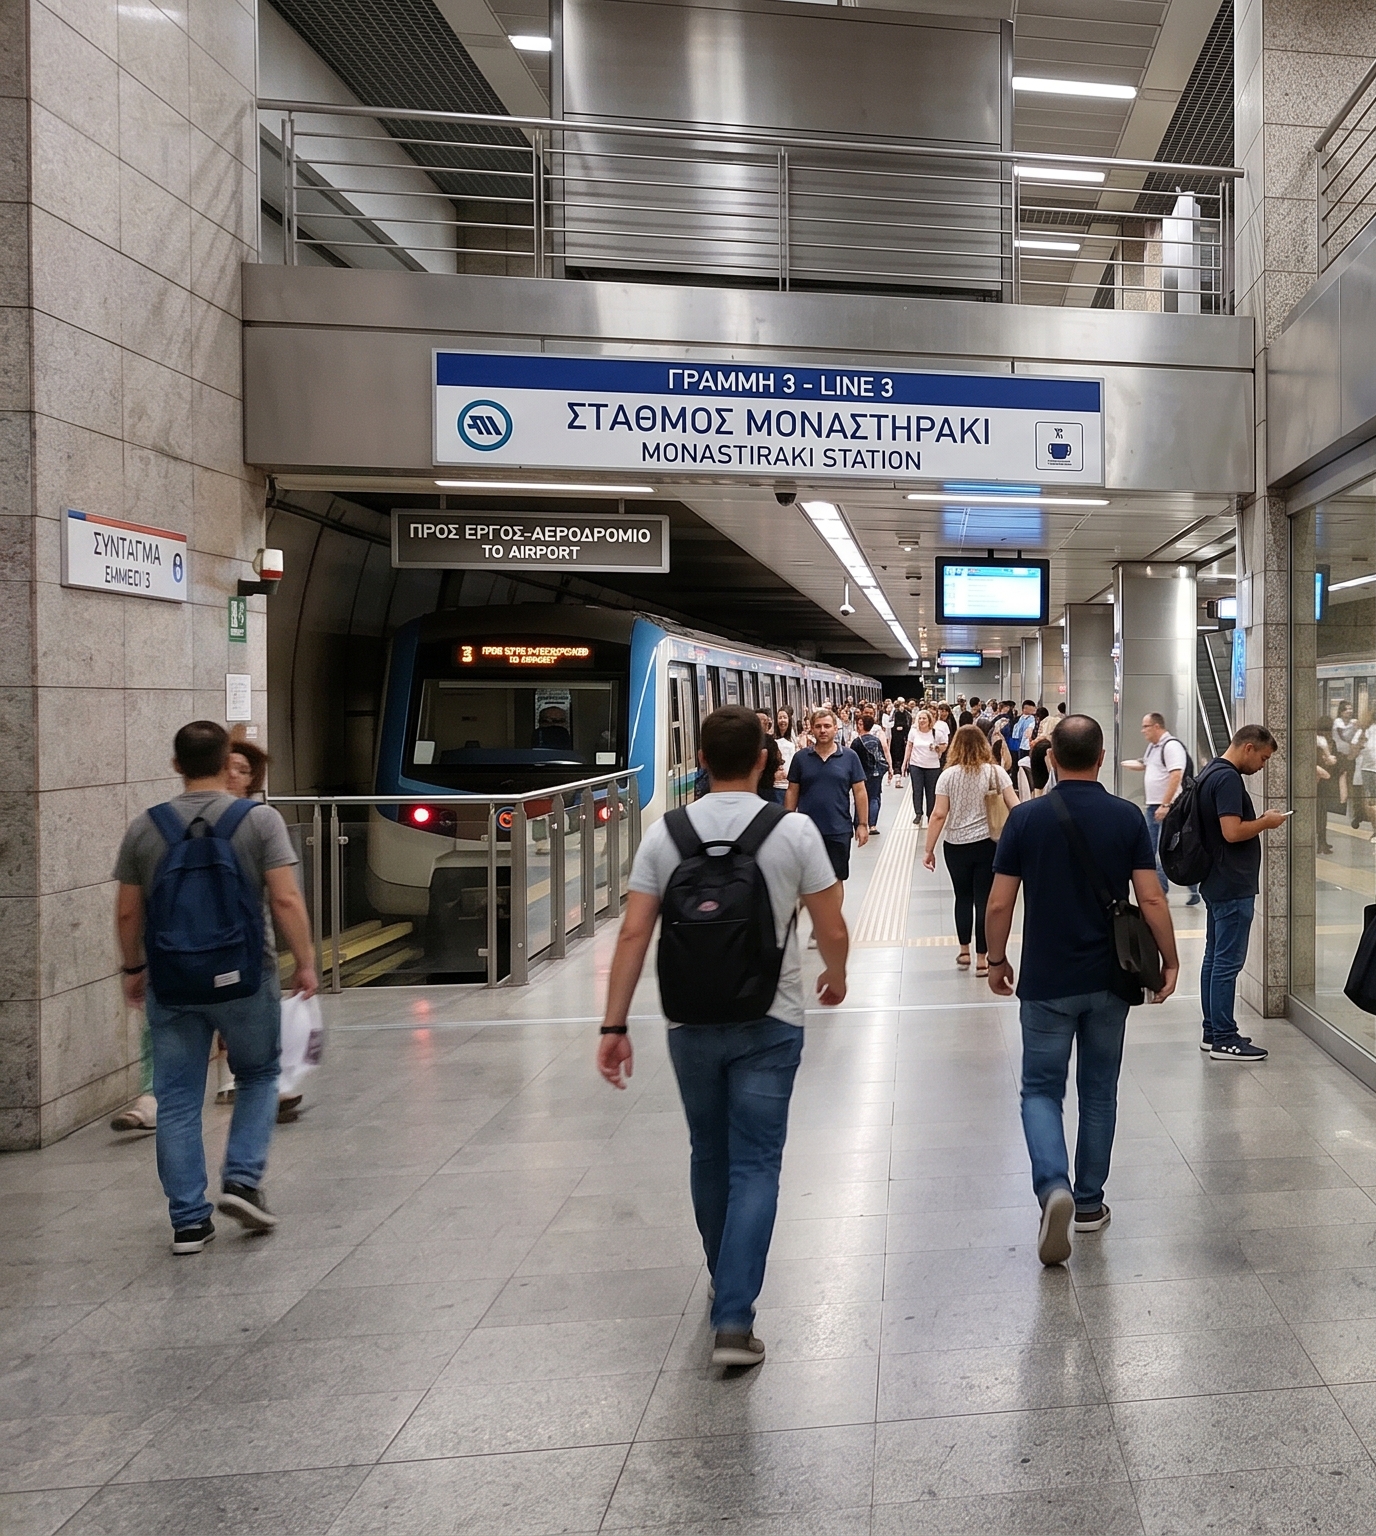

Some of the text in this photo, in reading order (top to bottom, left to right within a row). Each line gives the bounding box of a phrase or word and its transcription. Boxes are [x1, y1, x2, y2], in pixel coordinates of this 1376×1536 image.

[668, 369, 775, 393] ΓΡΑΜΜΗ
[782, 373, 796, 394] 3
[820, 375, 875, 397] LINE
[880, 377, 894, 398] 3
[567, 402, 990, 445] ΣΤΑΘΜΟΣ ΜΟΝΑΣΤΗΡΑΚΙ
[642, 441, 921, 471] MONASTIRAKI STATION
[409, 523, 651, 543] ΠΡΟΣ ΕΡΓΟΣ-ΑΕΡΟΔΡΟΜΙΟ
[93, 531, 162, 566] ΣΥΝΤΑΓΜΑ
[482, 544, 581, 559] TO AIRPORT
